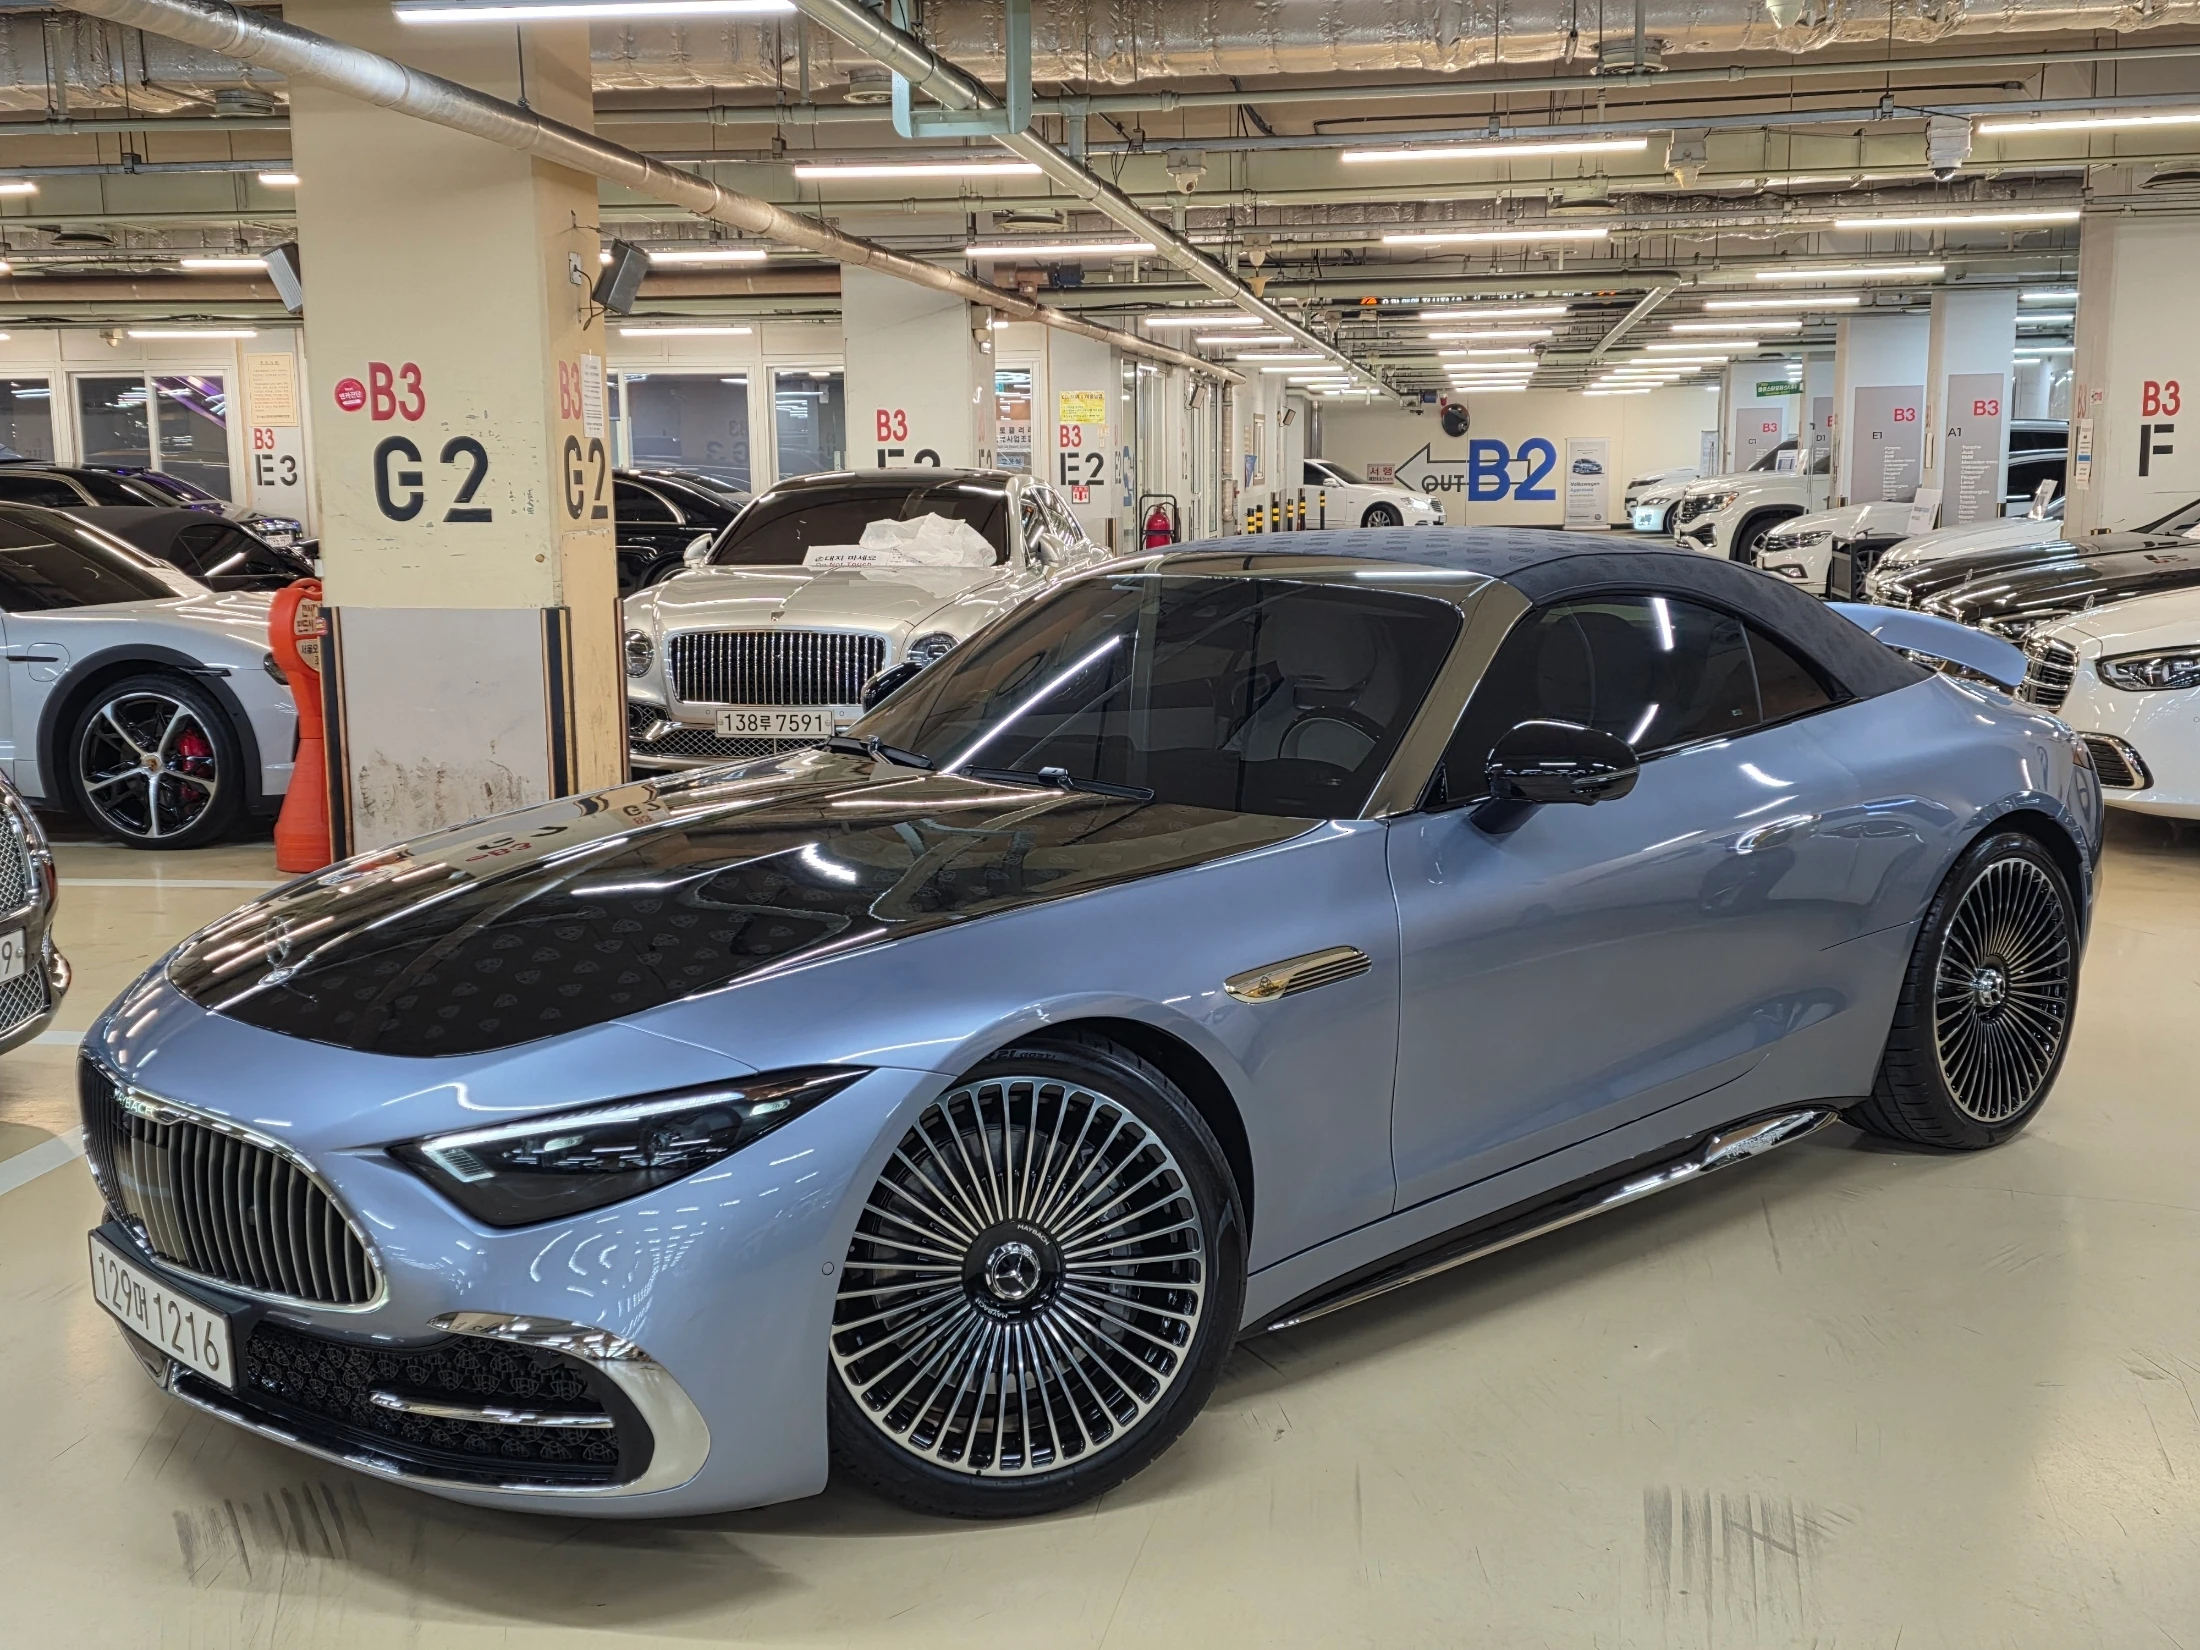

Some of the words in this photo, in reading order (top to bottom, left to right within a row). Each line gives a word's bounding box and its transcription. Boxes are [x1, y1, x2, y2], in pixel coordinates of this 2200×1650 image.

[368, 362, 425, 421] B3
[558, 359, 583, 420] B3
[2142, 380, 2181, 417] B3
[1894, 408, 1916, 422] B3
[1974, 400, 1999, 416] B3
[253, 428, 275, 449] B3
[876, 409, 908, 441] B3
[1060, 424, 1082, 447] B3
[1763, 423, 1778, 433] B3
[1947, 427, 1962, 437] A1
[2139, 424, 2174, 477] F
[255, 454, 298, 486] E3
[373, 435, 493, 522] G2
[563, 434, 609, 520] G2
[1060, 452, 1104, 485] E2
[1468, 437, 1557, 501] B2
[1421, 475, 1465, 493] OUT
[114, 1087, 153, 1116] MAYBACH
[1017, 1223, 1051, 1246] MAYBACH
[974, 1296, 1009, 1319] MAYBACH
